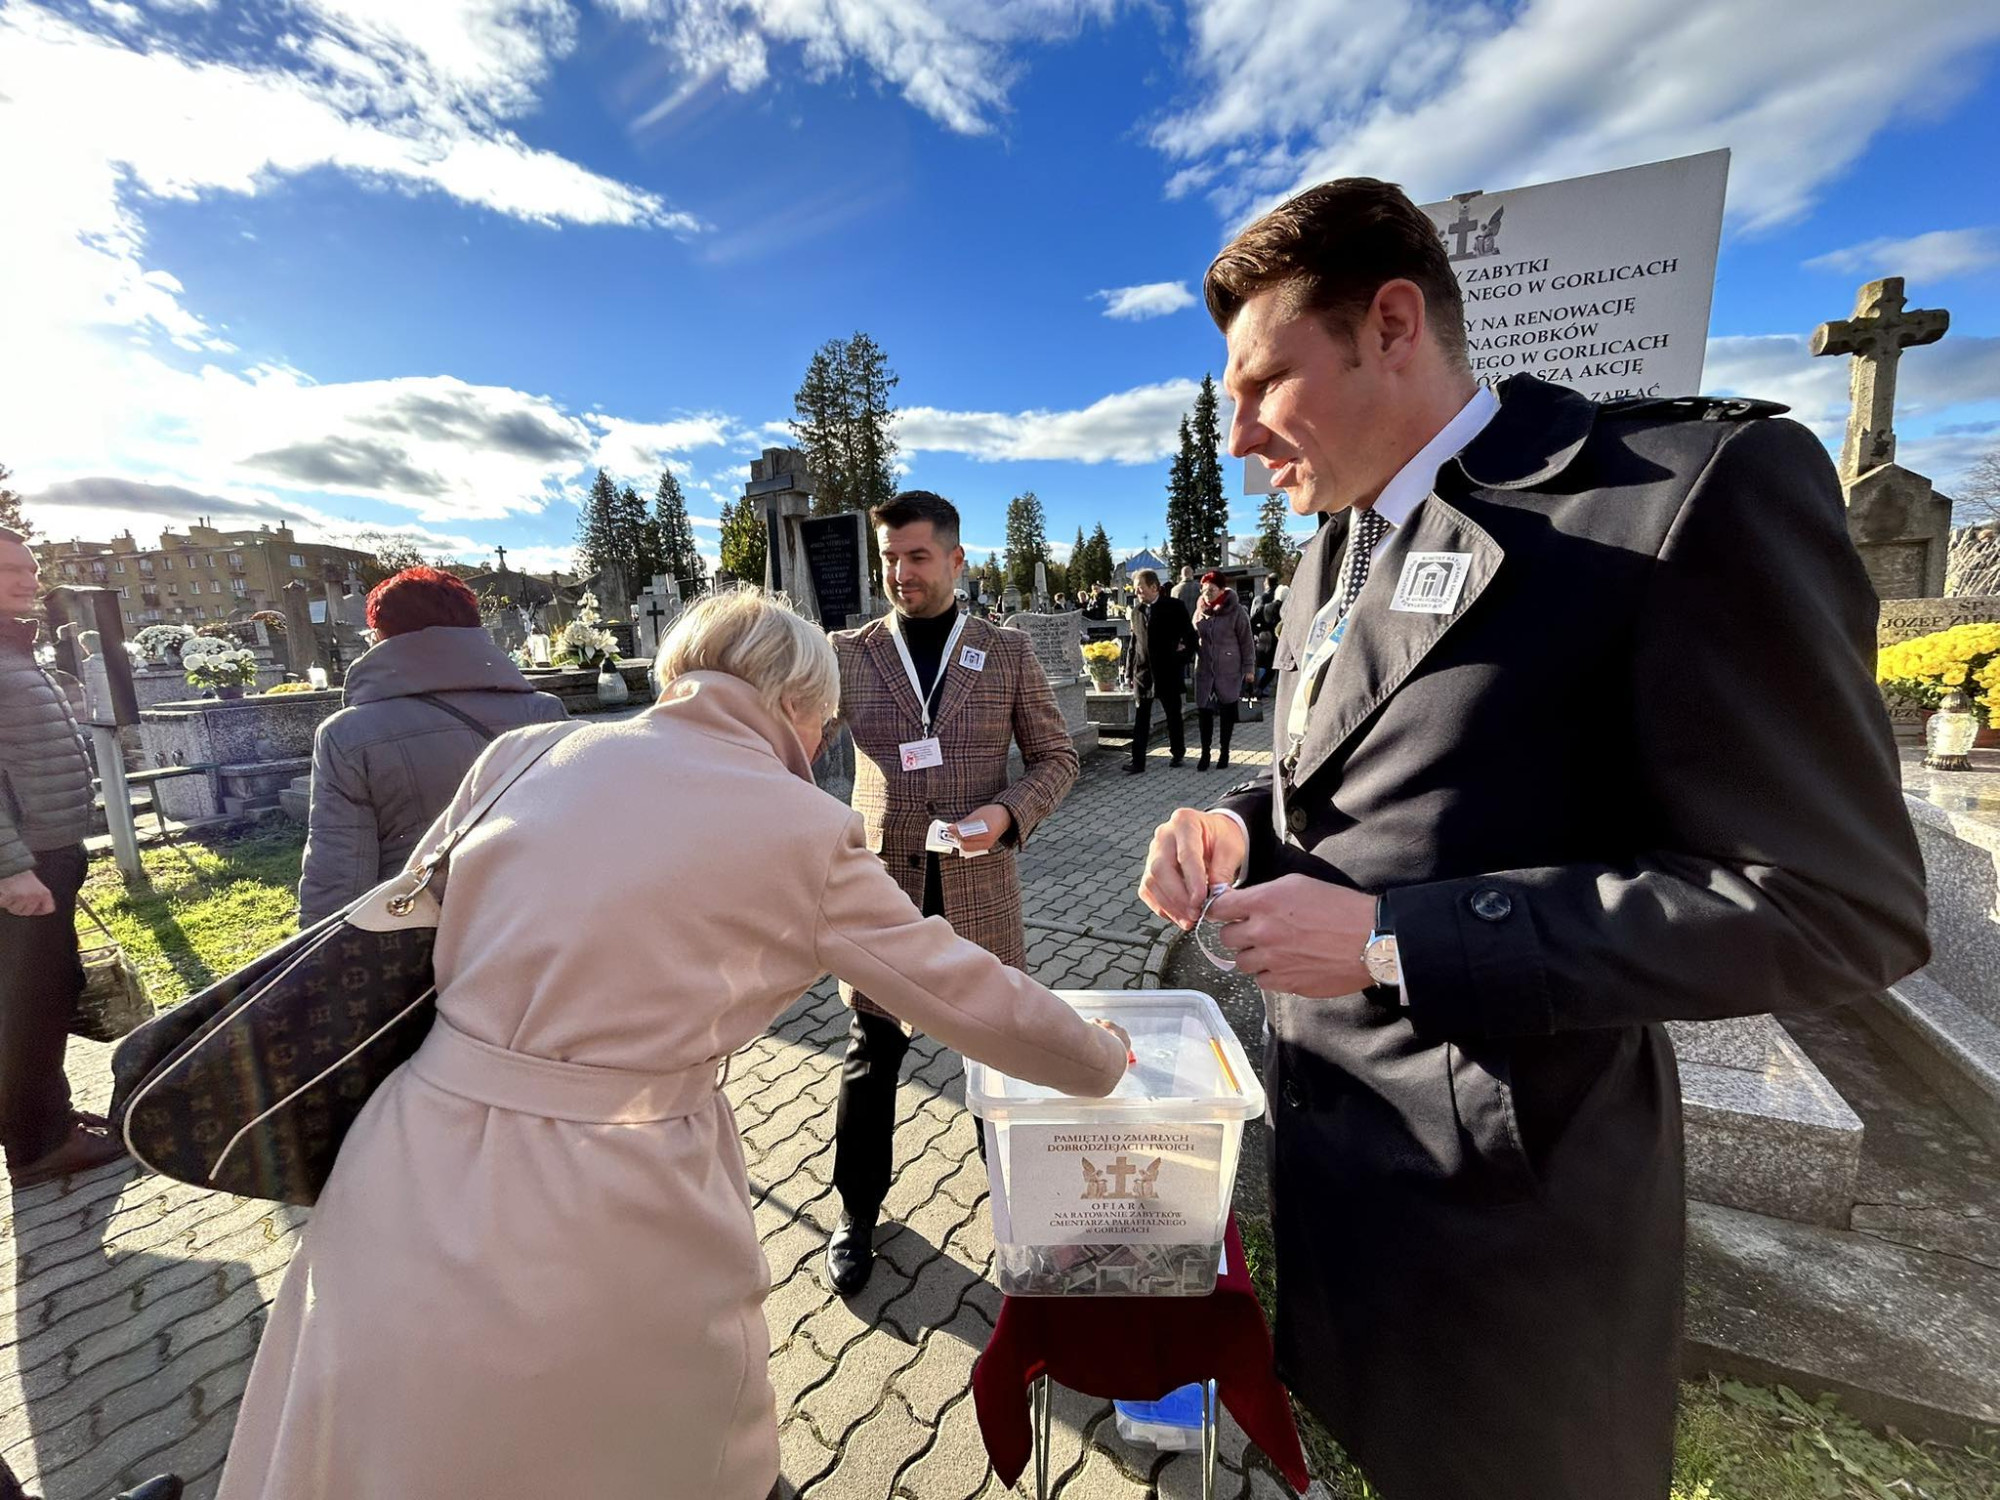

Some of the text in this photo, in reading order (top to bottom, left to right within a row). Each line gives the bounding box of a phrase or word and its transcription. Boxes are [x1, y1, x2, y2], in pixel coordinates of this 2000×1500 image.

[1466, 258, 1549, 283] ZABYTKI
[1463, 258, 1679, 304] NEGO W GORLICACH
[1481, 315, 1508, 331] NA
[1514, 297, 1636, 327] RENOWACJĘ
[1467, 321, 1599, 351] NAGROBKÓW
[1521, 350, 1539, 365] W
[1544, 333, 1669, 362] GORLICACH
[1579, 358, 1644, 378] AKCJĘ
[1054, 1134, 1189, 1144] PAMIĘTAJ O ZMARŁYCH
[1148, 1143, 1195, 1151] TWOICH
[1070, 1211, 1128, 1219] RATOWANIE
[1129, 1209, 1182, 1218] ZABYTKÓW
[1091, 1202, 1146, 1210] OFIARA
[1094, 1226, 1150, 1234] GORLICACH
